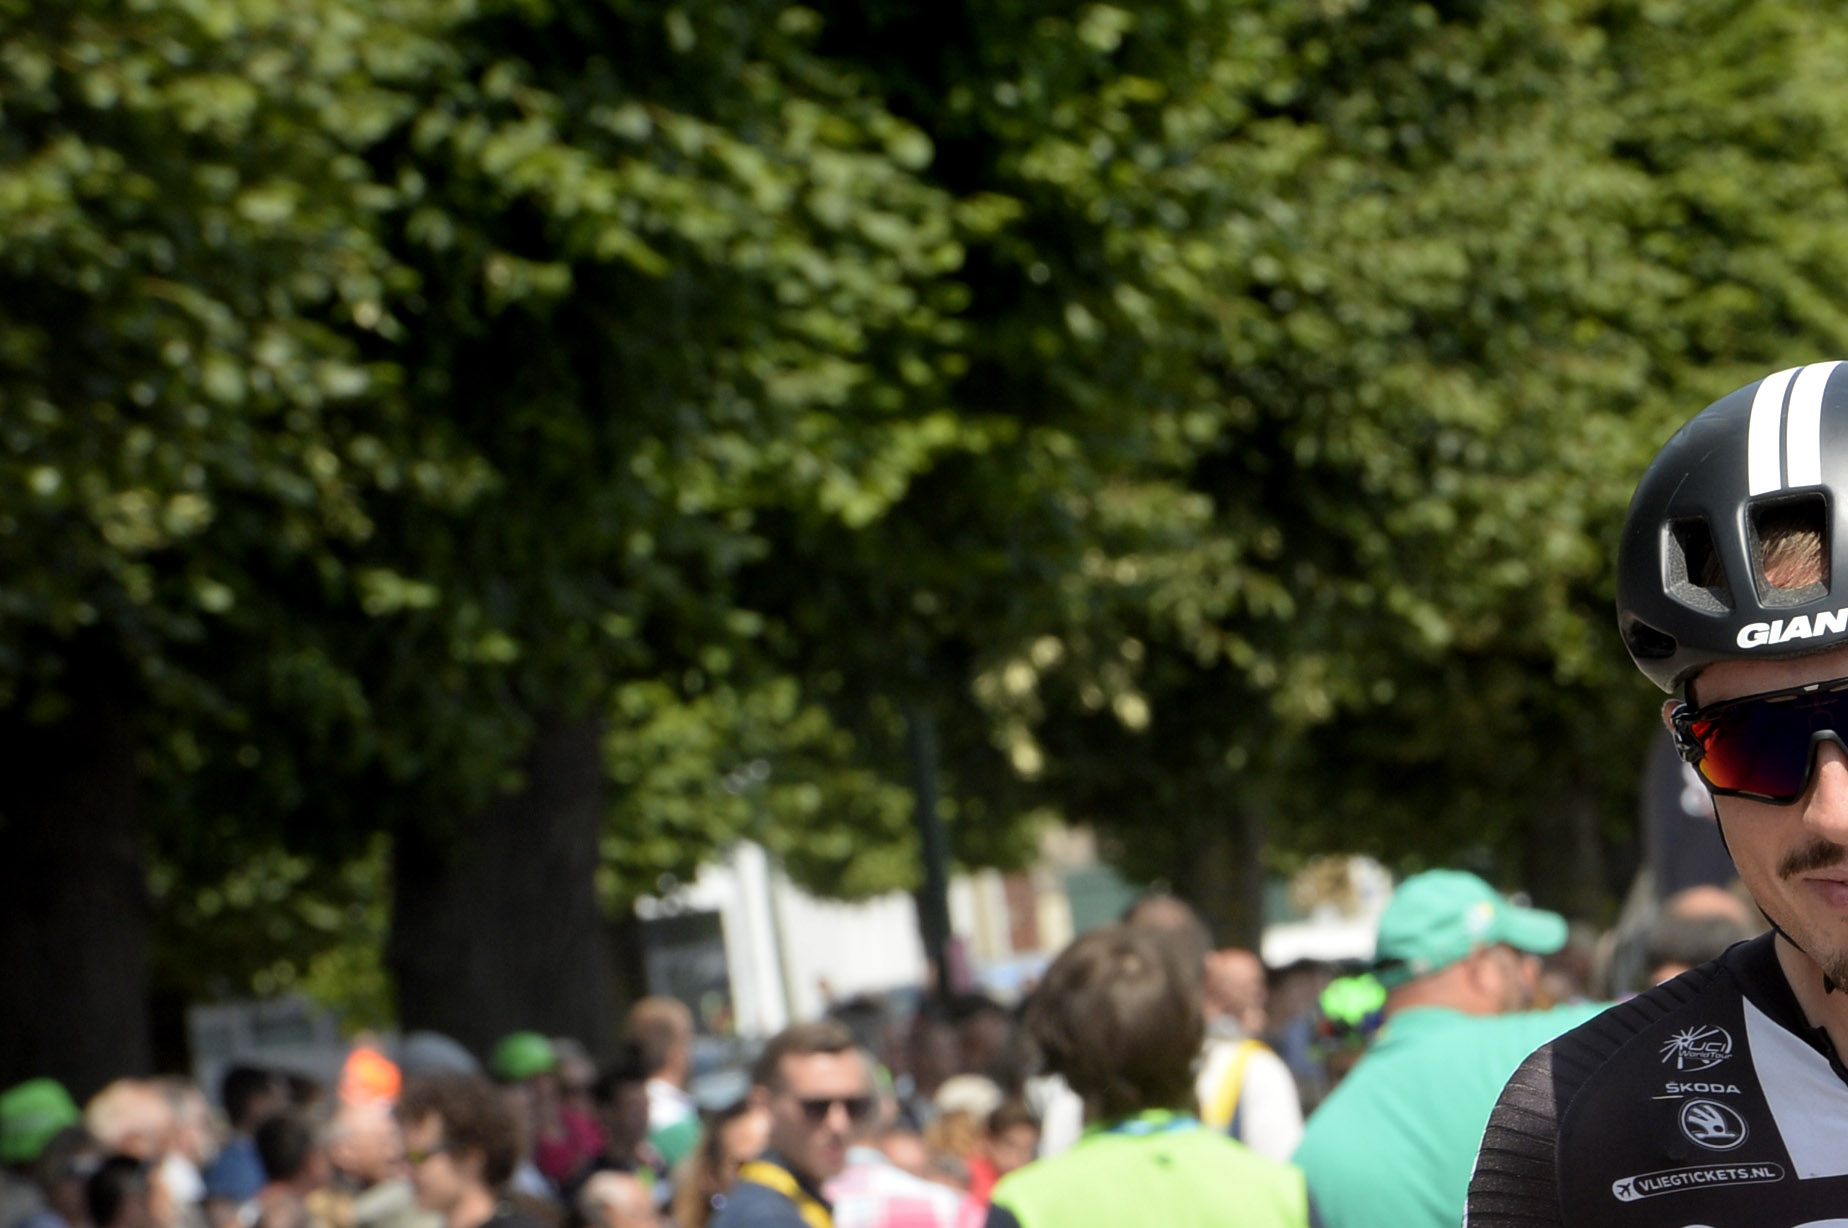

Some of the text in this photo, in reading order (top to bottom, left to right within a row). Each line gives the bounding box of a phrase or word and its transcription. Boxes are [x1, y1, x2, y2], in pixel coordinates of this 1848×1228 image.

[1688, 1041, 1727, 1052] UCI
[1665, 1080, 1741, 1094] ŠKODA
[1638, 1164, 1776, 1192] VLIEGTICKETS.NL
